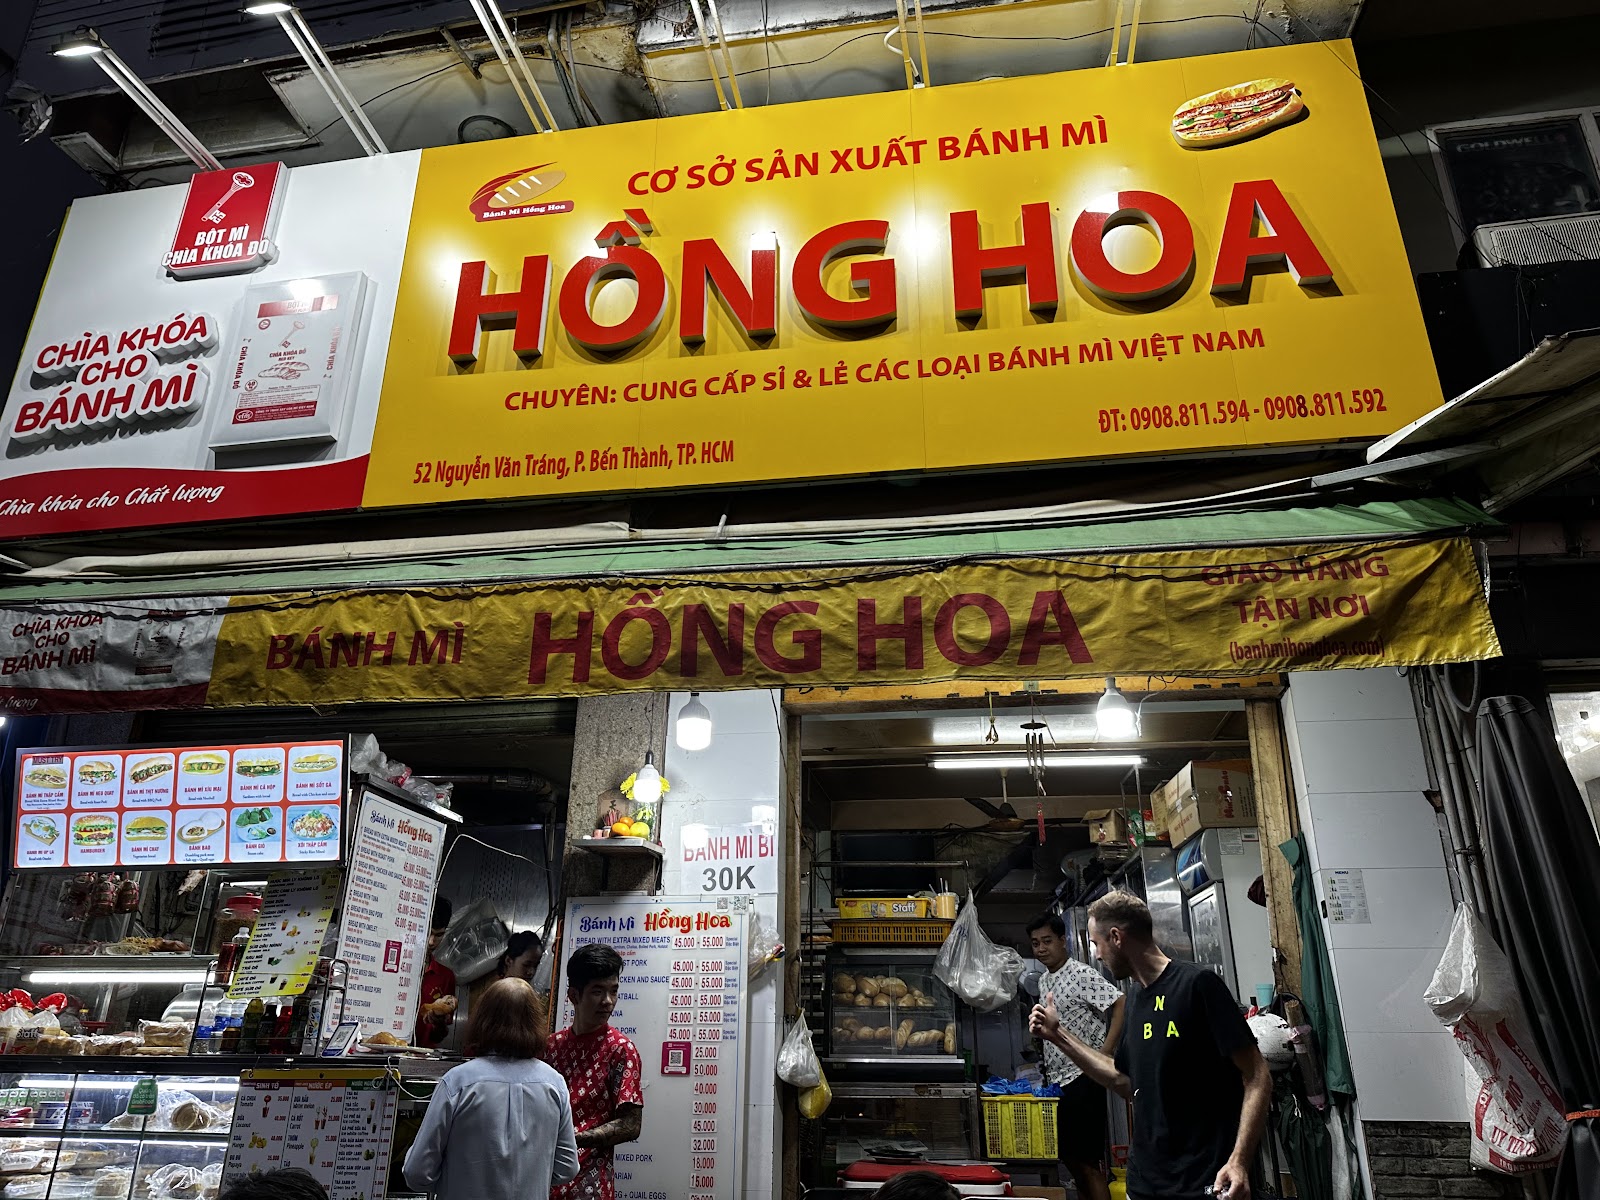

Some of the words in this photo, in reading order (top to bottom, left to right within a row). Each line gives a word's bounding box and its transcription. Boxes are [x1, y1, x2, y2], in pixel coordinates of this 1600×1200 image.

[627, 166, 678, 195] CƠ
[686, 154, 736, 190] SỞ
[745, 148, 818, 183] SẢN
[830, 136, 928, 174] XUẤT
[938, 125, 1050, 161] BÁNH
[1061, 114, 1108, 147] MÌ
[483, 211, 507, 219] Bánh
[194, 227, 227, 247] BỘT
[228, 224, 250, 242] MÌ
[162, 247, 198, 266] CHÌA
[201, 242, 243, 262] KHÓA
[448, 208, 898, 360] HỒNG
[950, 179, 1335, 317] HOA
[37, 334, 109, 369] CHÌA
[117, 314, 208, 352] KHÓA
[81, 355, 147, 386] CHO
[504, 383, 617, 412] CHUYÊN:
[623, 378, 698, 403] CUNG
[704, 369, 756, 396] CẤP
[762, 366, 785, 391] SỈ
[792, 369, 812, 389] &
[819, 360, 848, 386] LẺ
[855, 357, 910, 382] CÁC
[916, 353, 981, 381] LOẠI
[988, 345, 1071, 373] BÁNH
[1078, 337, 1114, 363] MÌ
[1118, 332, 1185, 361] VIỆT
[1192, 328, 1265, 353] NAM
[14, 387, 136, 434] BÁNH
[142, 363, 198, 409] MÌ
[1098, 407, 1127, 433] ĐT:
[1130, 399, 1250, 431] 0908.811.594
[1262, 388, 1387, 421] 0908.811.592
[413, 462, 432, 484] 52
[434, 454, 491, 487] Nguyễn
[494, 454, 522, 479] Văn
[525, 451, 571, 480] Tráng,
[573, 451, 586, 474] P.
[589, 446, 620, 471] Bến
[622, 444, 673, 471] Thành,
[676, 442, 698, 466] TP.
[700, 440, 735, 463] HCM
[0, 499, 35, 516] Chìa
[38, 494, 83, 513] khóa
[86, 490, 120, 509] cho
[124, 485, 170, 506] Chất
[172, 483, 225, 503] lượng
[1201, 562, 1283, 587] GIAO
[1290, 556, 1390, 583] HÀNG
[1232, 595, 1300, 628] TẬN
[1308, 593, 1371, 620] NƠI
[12, 617, 51, 638] CHÌA
[34, 631, 70, 649] CHO
[527, 589, 823, 685] HỒNG
[857, 589, 1094, 672] HOA
[266, 626, 396, 670] BÁNH
[407, 621, 465, 666] MÌ
[1229, 635, 1386, 664] (banhmihonghoa.com)
[1, 649, 65, 676] BÁNH
[67, 639, 97, 666] MÌ
[736, 828, 753, 859] MÌ
[702, 865, 756, 892] 30K
[892, 902, 916, 913] Staff
[580, 916, 616, 933] Bánh
[619, 916, 635, 931] Mì
[644, 907, 692, 934] Hồng
[695, 911, 732, 931] Hoa
[632, 936, 651, 944] MIXED
[674, 937, 695, 948] 45.000
[702, 936, 723, 947] 55.000
[631, 959, 648, 967] PORK
[672, 961, 694, 972] 45.000
[701, 960, 723, 972] 55.000
[619, 975, 636, 983] CKEN
[637, 975, 649, 983] AND
[650, 975, 670, 983] SAUCE
[671, 977, 692, 988] 45.000
[701, 977, 723, 988] 55.000
[617, 992, 639, 1000] ATBALL
[670, 995, 691, 1006] 45.000
[700, 994, 721, 1006] 55.000
[1154, 995, 1165, 1011] N
[670, 1012, 691, 1023] 45.000
[699, 1011, 721, 1023] 55.000
[620, 1027, 637, 1035] PORK
[669, 1028, 691, 1040] 45.000
[698, 1029, 720, 1040] 55.000
[1143, 1022, 1153, 1040] B
[1166, 1020, 1180, 1038] A
[695, 1046, 717, 1058] 25.000
[694, 1064, 718, 1076] 50.000
[694, 1083, 717, 1094] 40.000
[693, 1102, 717, 1113] 30.000
[693, 1120, 715, 1131] 45.000
[692, 1139, 715, 1151] 32.000
[615, 1153, 635, 1162] MIXED
[635, 1154, 653, 1162] PORK
[692, 1156, 715, 1169] 18.000
[691, 1174, 714, 1188] 15.000
[648, 1191, 667, 1200] EGGS
